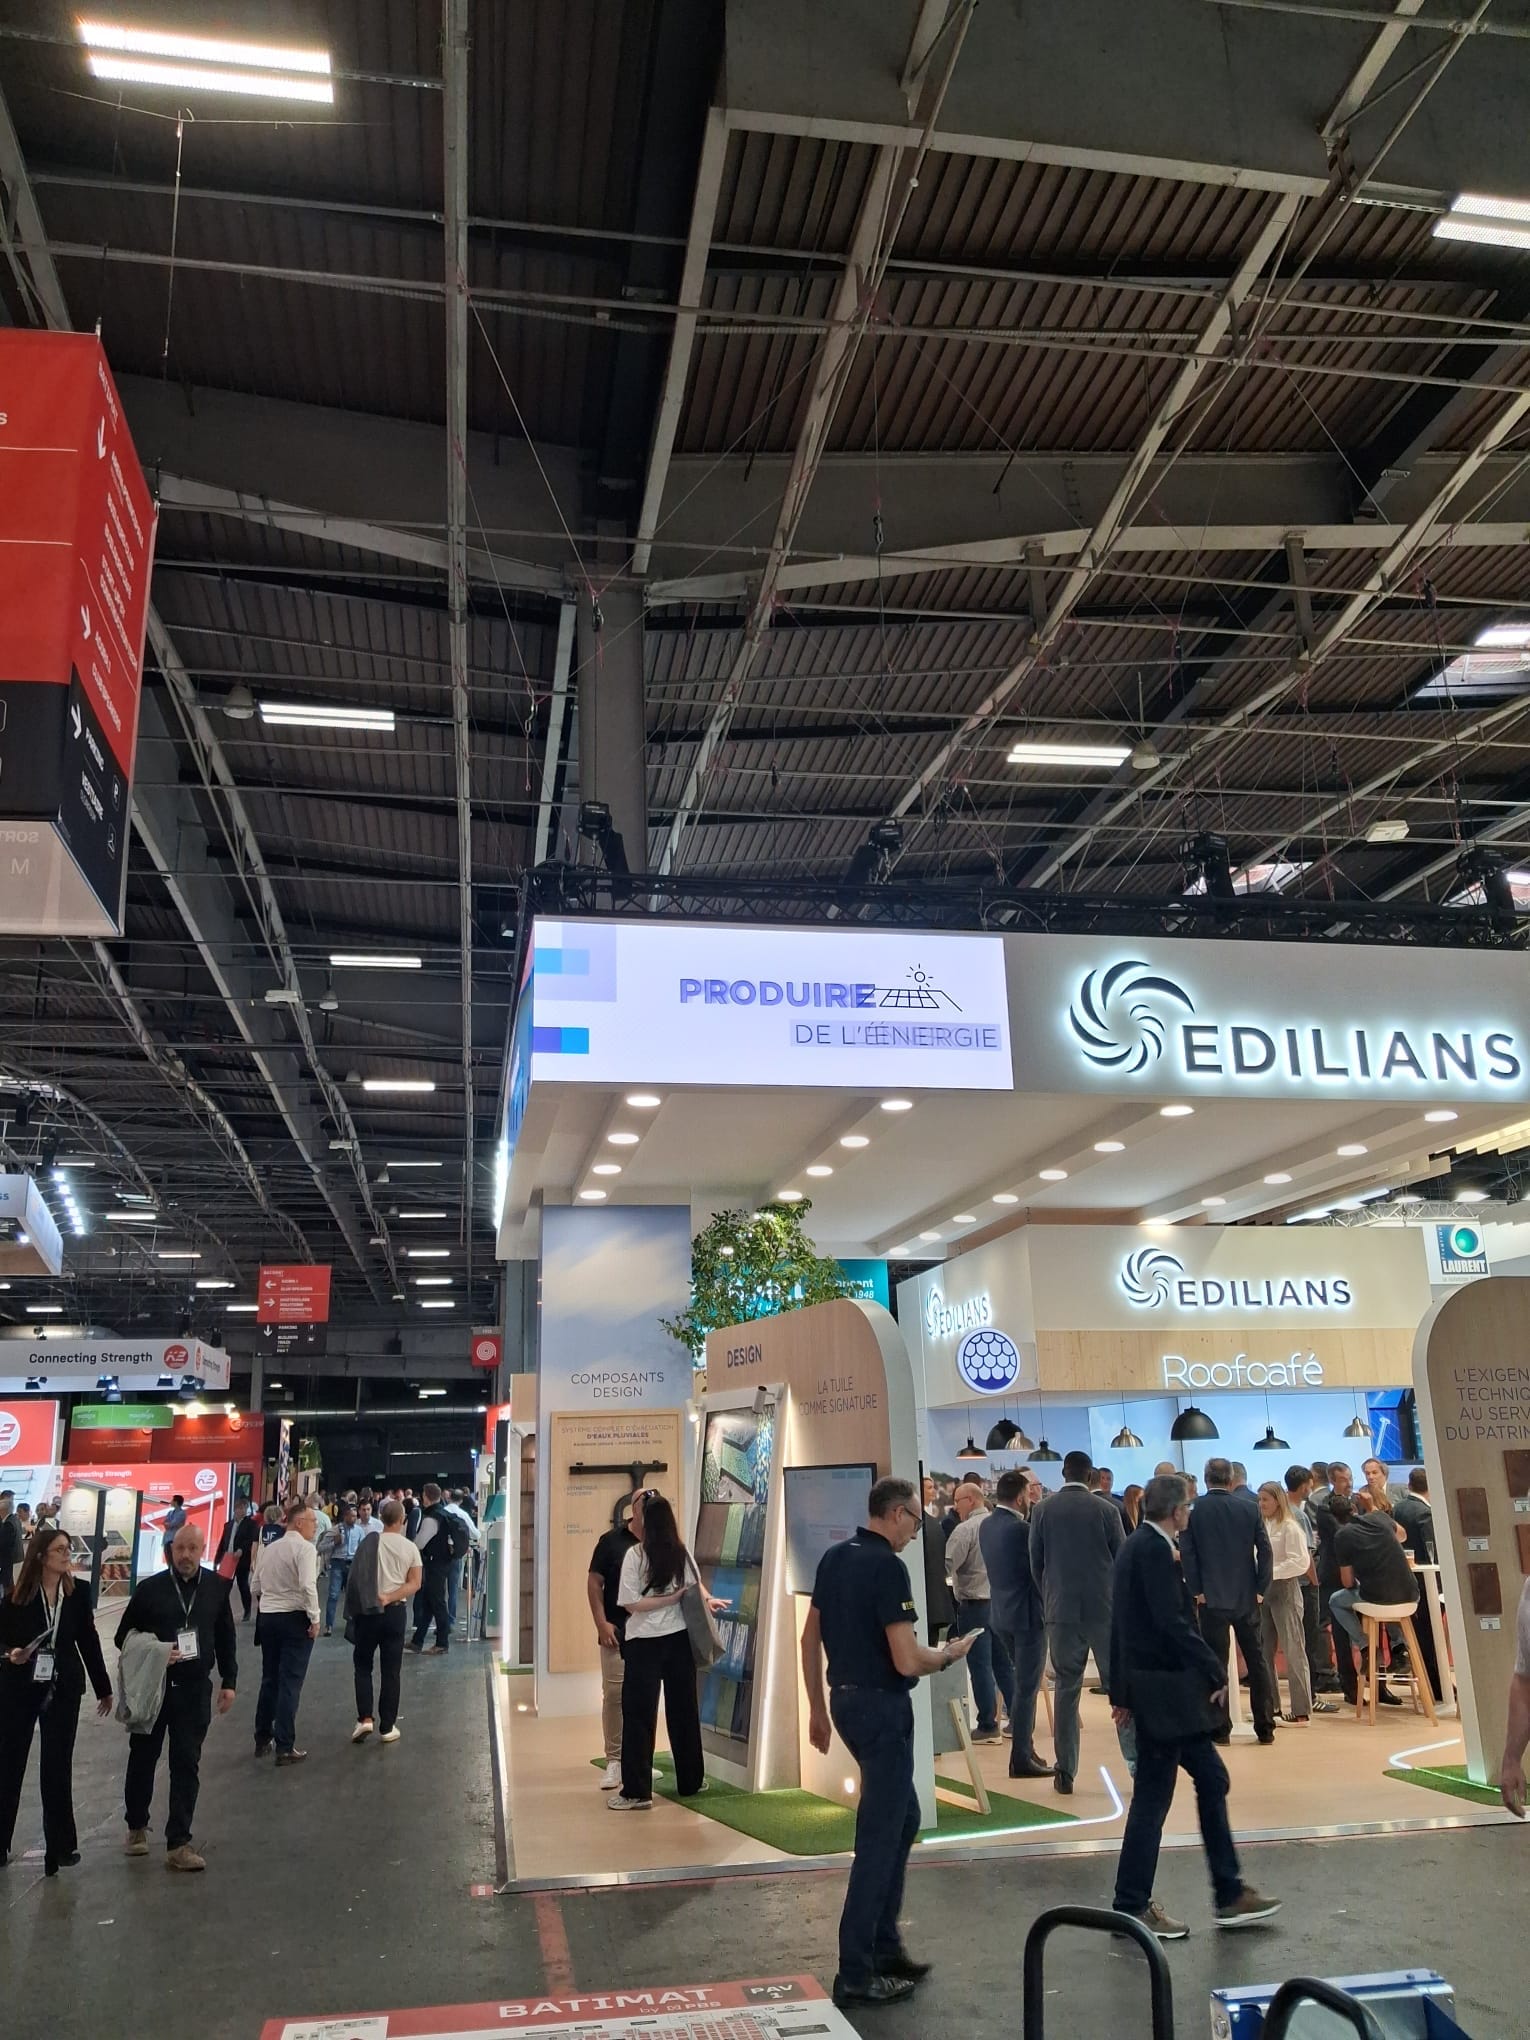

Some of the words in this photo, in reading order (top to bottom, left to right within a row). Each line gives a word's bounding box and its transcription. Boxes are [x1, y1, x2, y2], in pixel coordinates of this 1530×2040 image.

[679, 978, 876, 1009] PRODUIRE
[795, 1023, 832, 1046] DE
[1182, 1024, 1521, 1081] EDILIANS
[1441, 1260, 1486, 1273] LAURENT
[1177, 1280, 1352, 1307] EDILIANS
[939, 1295, 989, 1335] EDILIANS
[29, 1352, 97, 1365] Connecting
[100, 1352, 153, 1365] Strength
[727, 1344, 762, 1369] DESIGN
[570, 1371, 665, 1385] COMPOSANTS
[1162, 1352, 1324, 1389] Roofcafé
[593, 1386, 643, 1398] DESIGN
[817, 1379, 829, 1395] LA
[829, 1376, 854, 1393] TUILE
[828, 1393, 878, 1414] SIGNATURE
[1460, 1406, 1483, 1421] AU
[1446, 1426, 1470, 1441] DU
[68, 1471, 104, 1479] Connecting
[751, 1985, 793, 1994] PAV
[499, 1988, 713, 2019] BATIMAT
[639, 2006, 660, 2015] by
